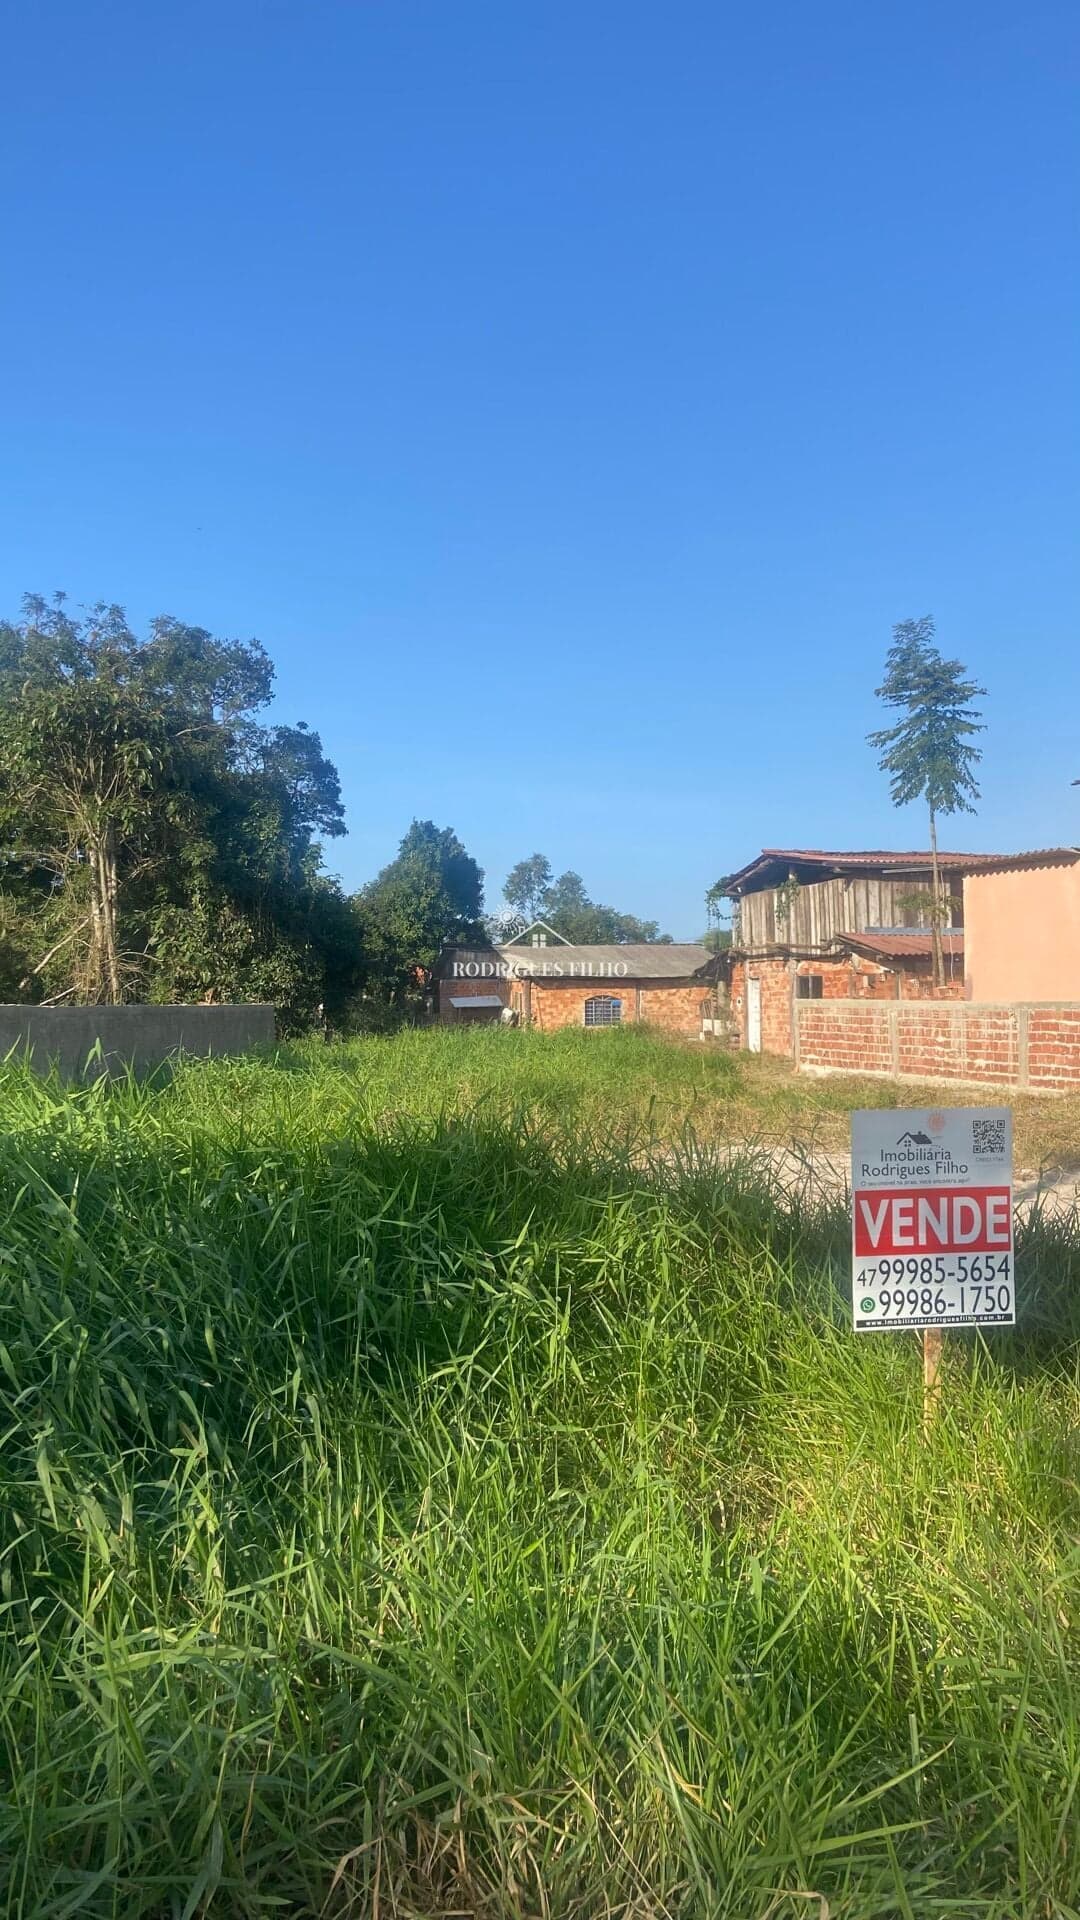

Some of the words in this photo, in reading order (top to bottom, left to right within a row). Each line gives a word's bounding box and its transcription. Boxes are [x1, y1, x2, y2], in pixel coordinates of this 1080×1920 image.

[861, 1163, 930, 1180] Rodrigues
[935, 1161, 969, 1175] Filho
[880, 1148, 952, 1162] Imobiliária
[859, 1195, 1009, 1249] VENDE
[878, 1254, 1010, 1287] 99985-5654
[879, 1285, 1010, 1317] 99986-1750
